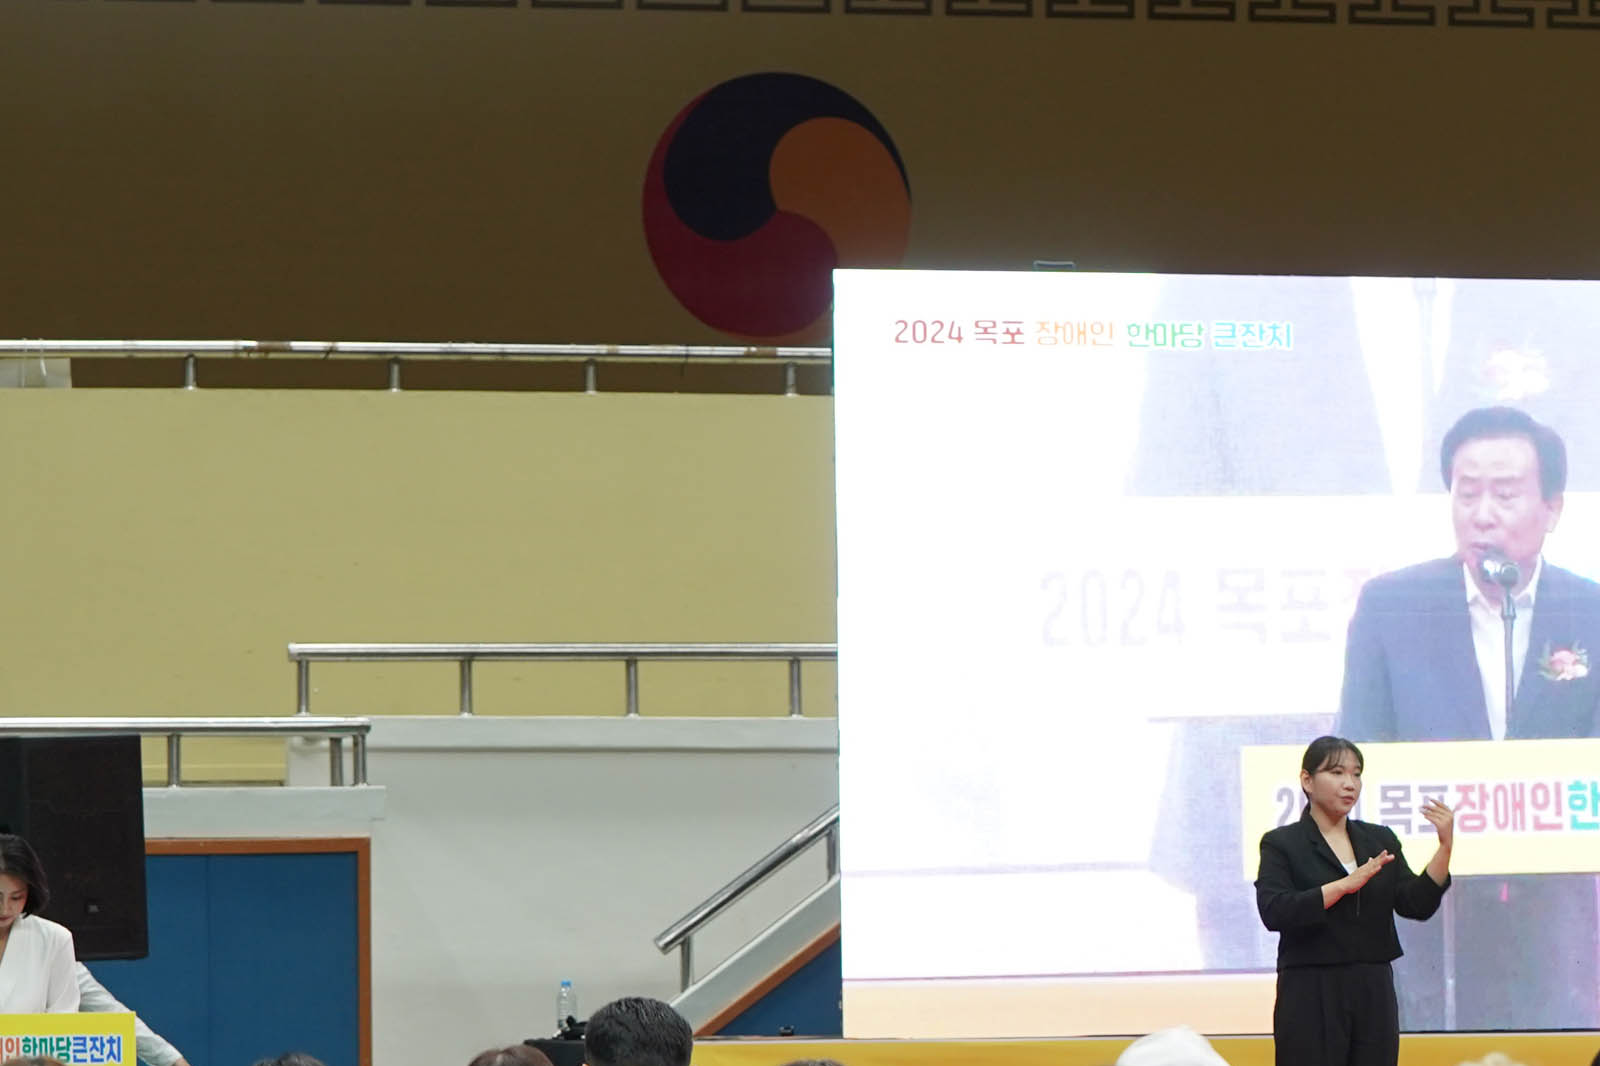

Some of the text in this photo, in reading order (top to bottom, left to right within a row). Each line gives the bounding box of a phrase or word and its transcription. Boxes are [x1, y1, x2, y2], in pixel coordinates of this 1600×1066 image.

[894, 319, 1293, 349] 2024 목포 장애인 한마당 큰잔치
[1041, 567, 1187, 647] 2024
